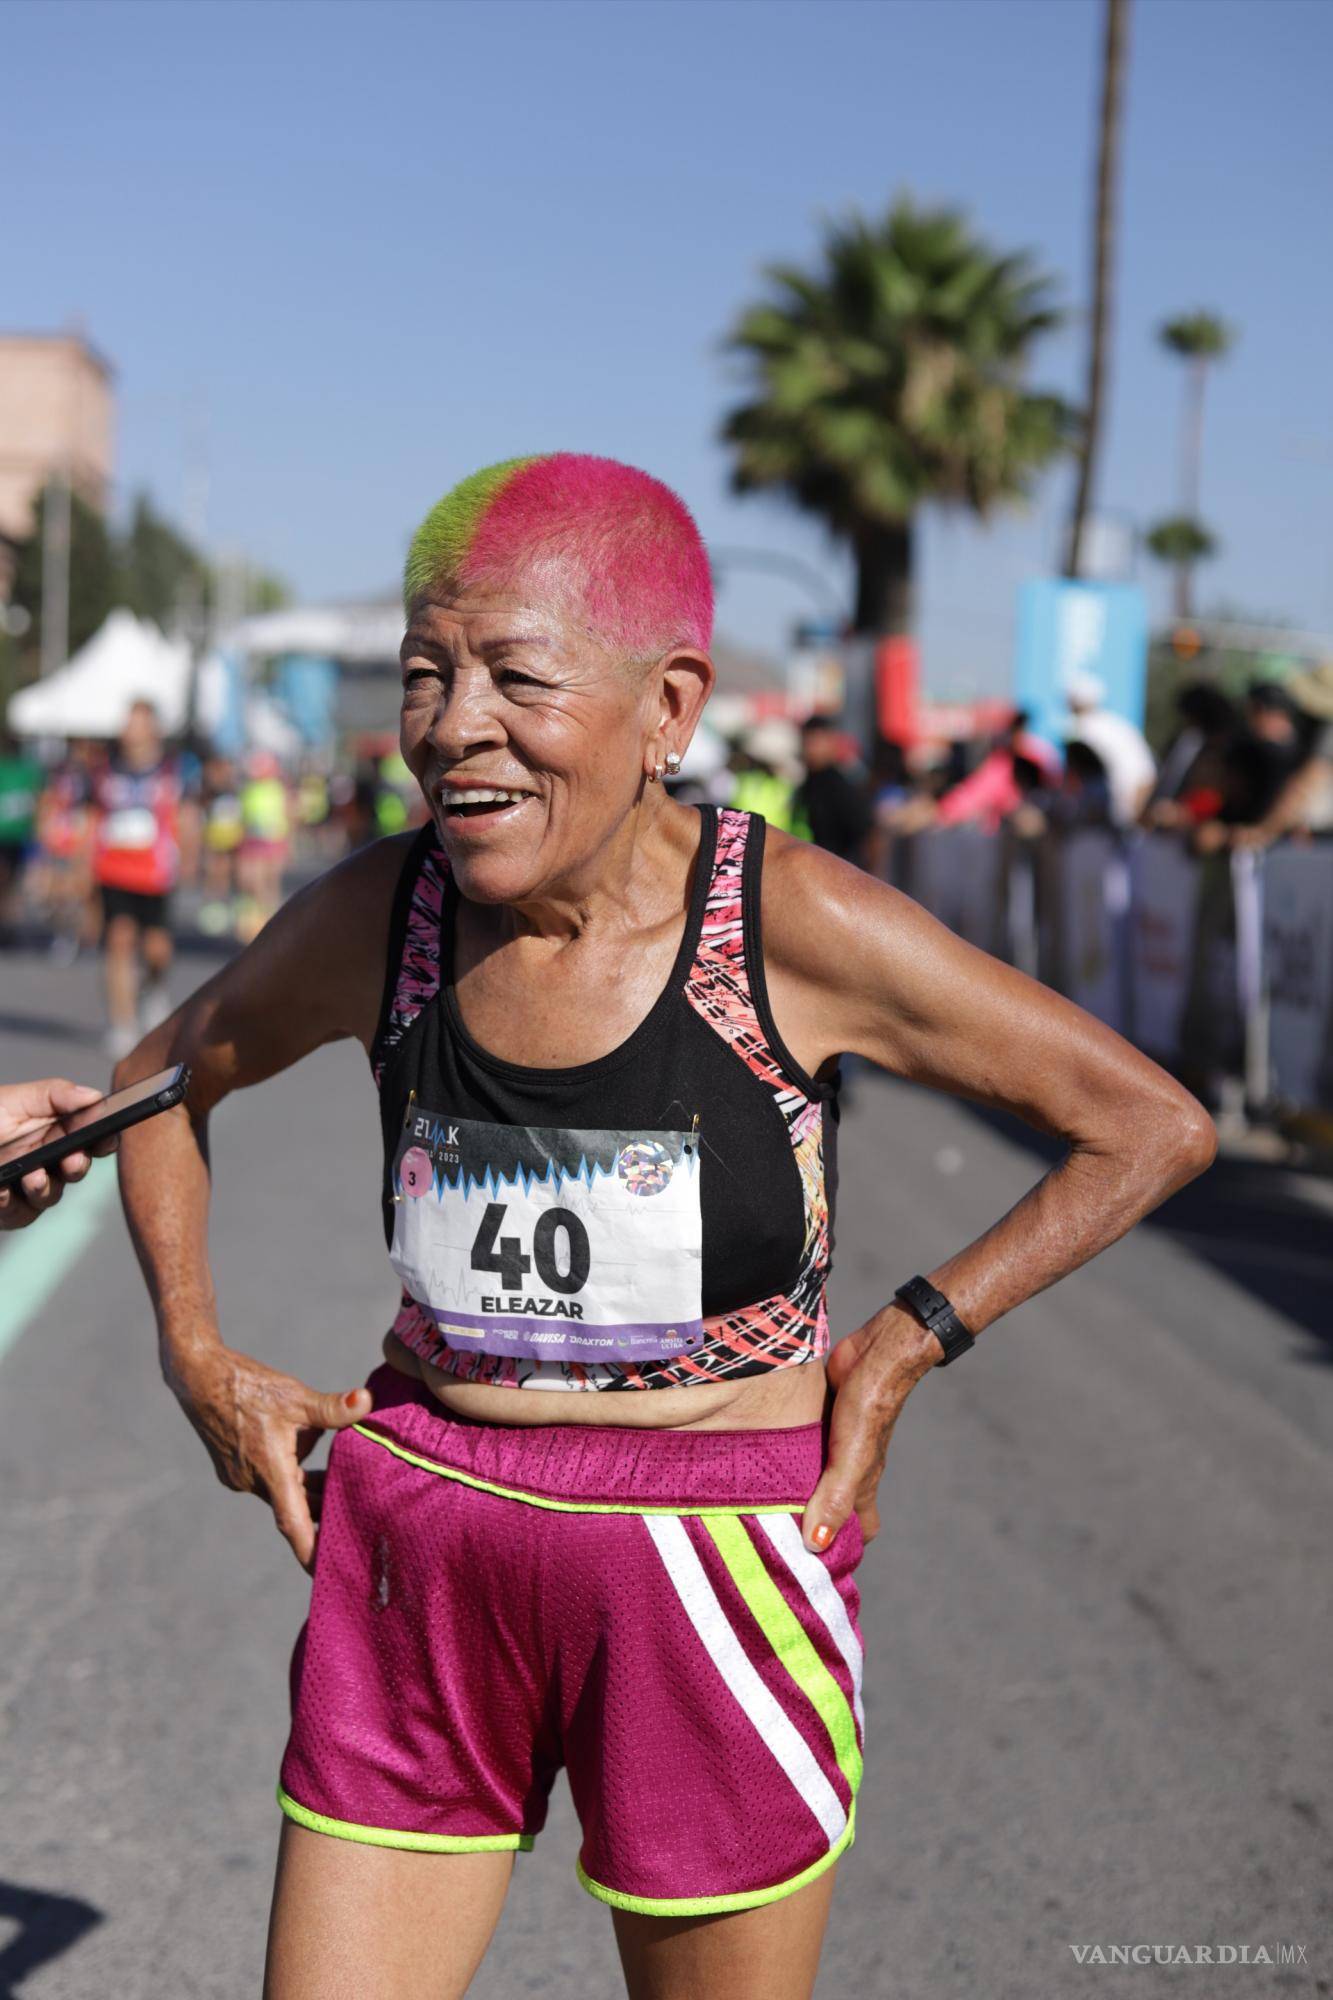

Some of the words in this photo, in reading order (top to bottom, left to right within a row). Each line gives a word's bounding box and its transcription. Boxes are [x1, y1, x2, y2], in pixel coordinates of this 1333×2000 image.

[438, 1151, 460, 1164] 2023
[408, 1171, 416, 1186] 3
[471, 1203, 591, 1294] 40
[481, 1296, 584, 1320] ELEAZAR
[569, 1335, 614, 1346] DRAXTON
